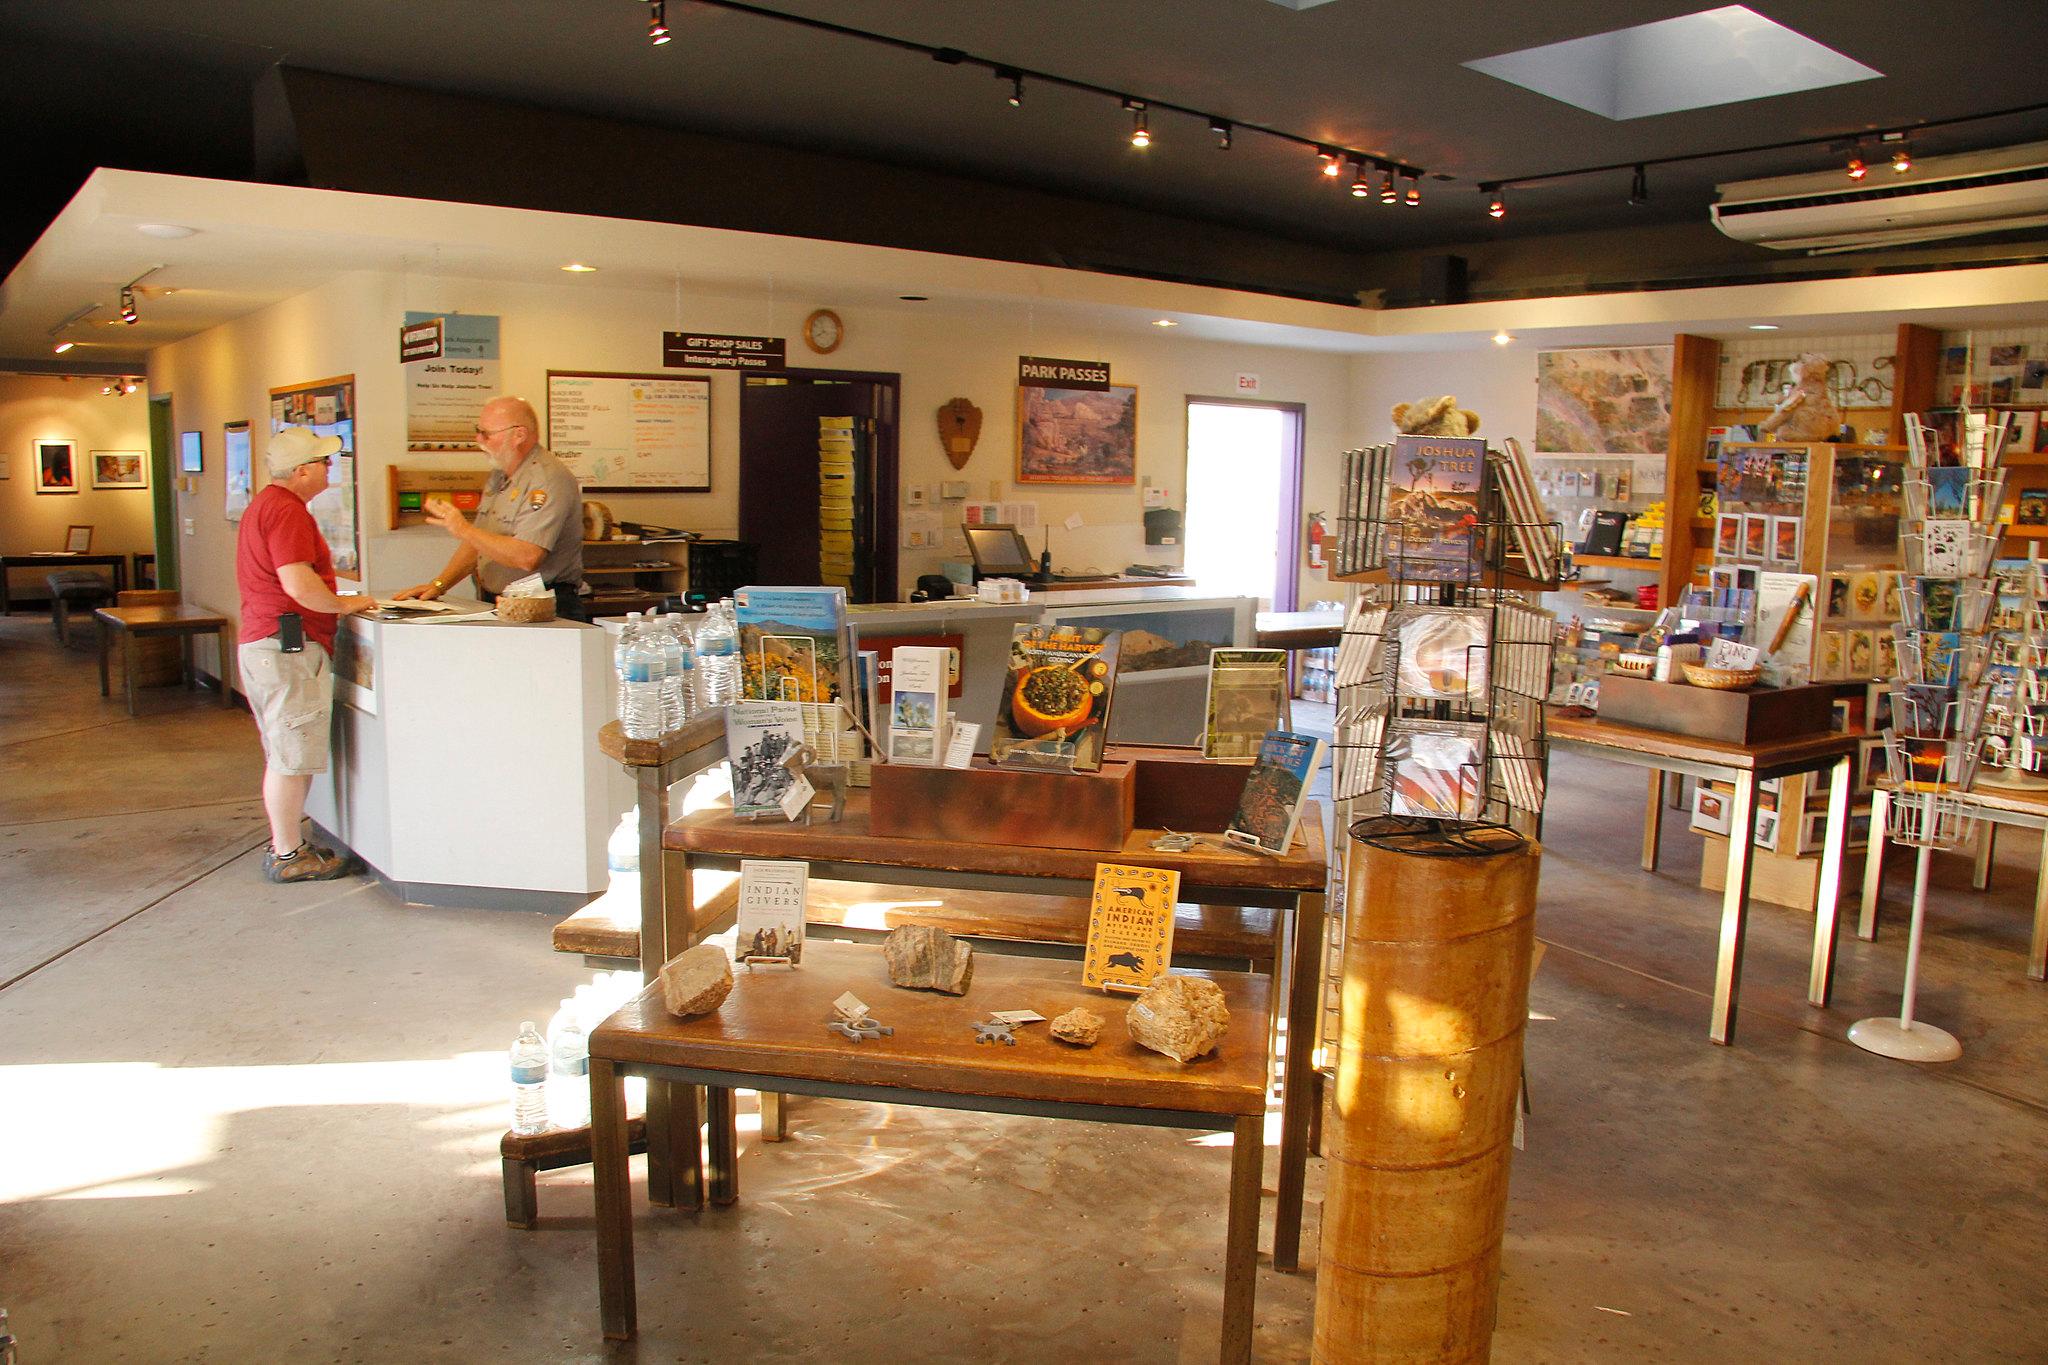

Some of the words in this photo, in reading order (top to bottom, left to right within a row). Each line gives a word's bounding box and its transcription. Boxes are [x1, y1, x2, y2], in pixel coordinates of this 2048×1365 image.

[686, 338, 708, 347] GIFT
[709, 339, 734, 349] SHOP
[735, 340, 763, 350] SALES
[684, 354, 738, 367] Interagency
[738, 357, 767, 367] Passes
[425, 364, 446, 373] Join
[450, 365, 484, 376] Today!
[1021, 364, 1058, 379] PARK
[1060, 367, 1108, 383] PASSES
[1240, 376, 1257, 389] Exit
[1416, 446, 1476, 458] JOSHUA
[1440, 461, 1474, 473] TREE
[1039, 641, 1058, 650] THE
[1720, 641, 1752, 661] PINE
[732, 707, 768, 716] National
[747, 886, 800, 895] INDIAN
[747, 896, 799, 906] GIVERS
[1108, 906, 1155, 917] AMERICAN
[1107, 914, 1154, 926] INDIAN
